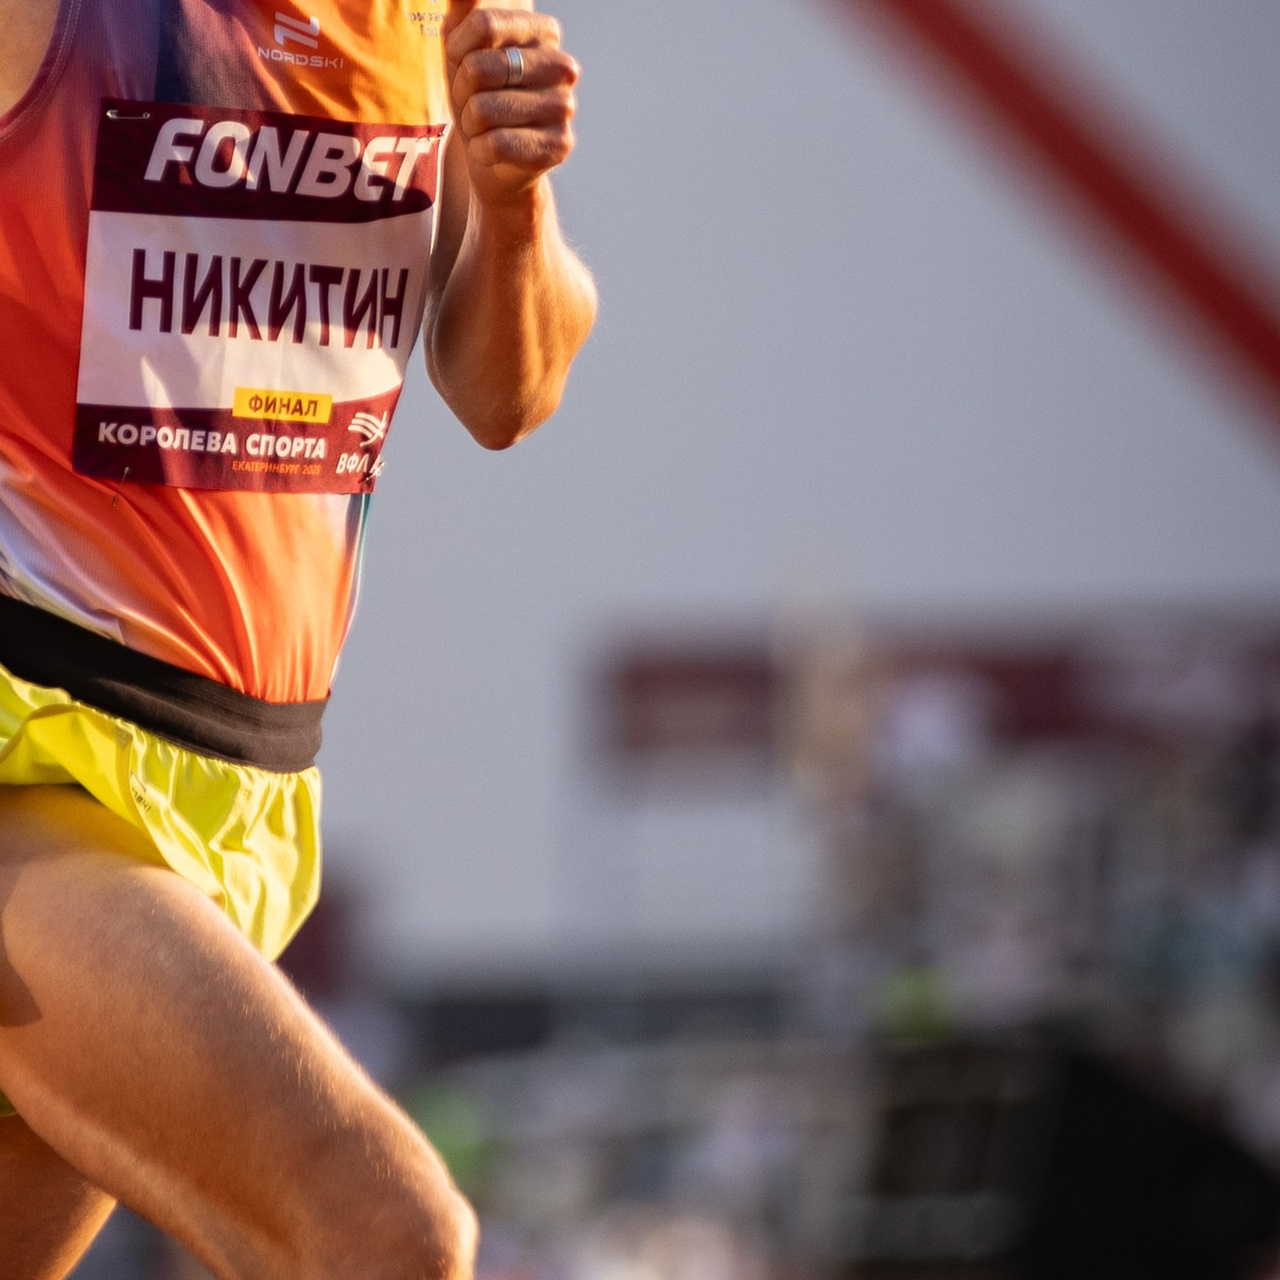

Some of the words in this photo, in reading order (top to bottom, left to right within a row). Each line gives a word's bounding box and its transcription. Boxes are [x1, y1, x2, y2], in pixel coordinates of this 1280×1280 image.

[258, 46, 344, 69] NORDSKI
[144, 117, 432, 202] FONBET
[129, 248, 409, 350] НИКИТИН
[248, 394, 318, 417] ФИНАЛ
[98, 422, 237, 455] КОРОЛЕВА
[246, 433, 326, 460] СПОРТА
[232, 460, 299, 475] ЕКАТЕРИНБУРГ
